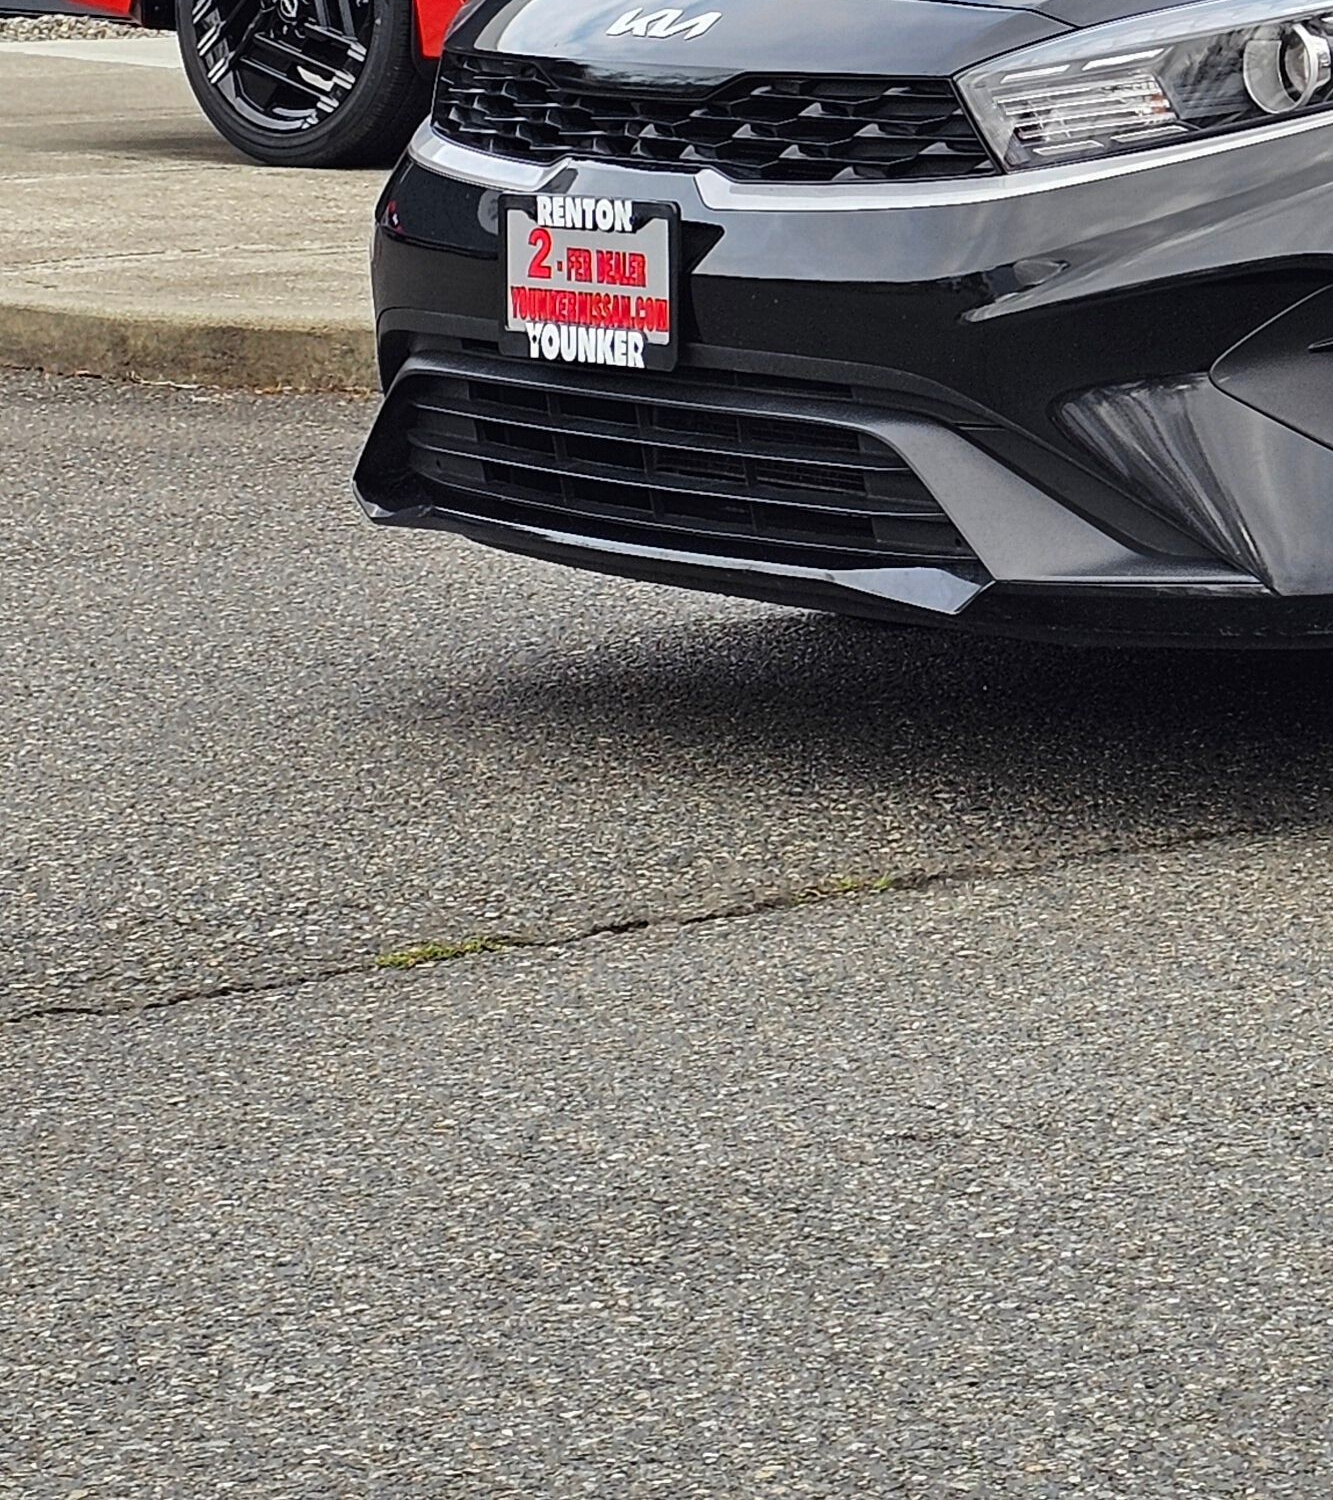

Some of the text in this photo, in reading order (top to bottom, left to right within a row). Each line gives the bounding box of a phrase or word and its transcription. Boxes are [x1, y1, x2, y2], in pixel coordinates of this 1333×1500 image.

[606, 7, 722, 41] KIA
[536, 196, 633, 231] RENTON
[528, 228, 552, 279] 2
[596, 249, 647, 288] DEALER
[510, 285, 668, 333] YOUNKERNISSAN.COM
[525, 322, 645, 369] YOUNKER
